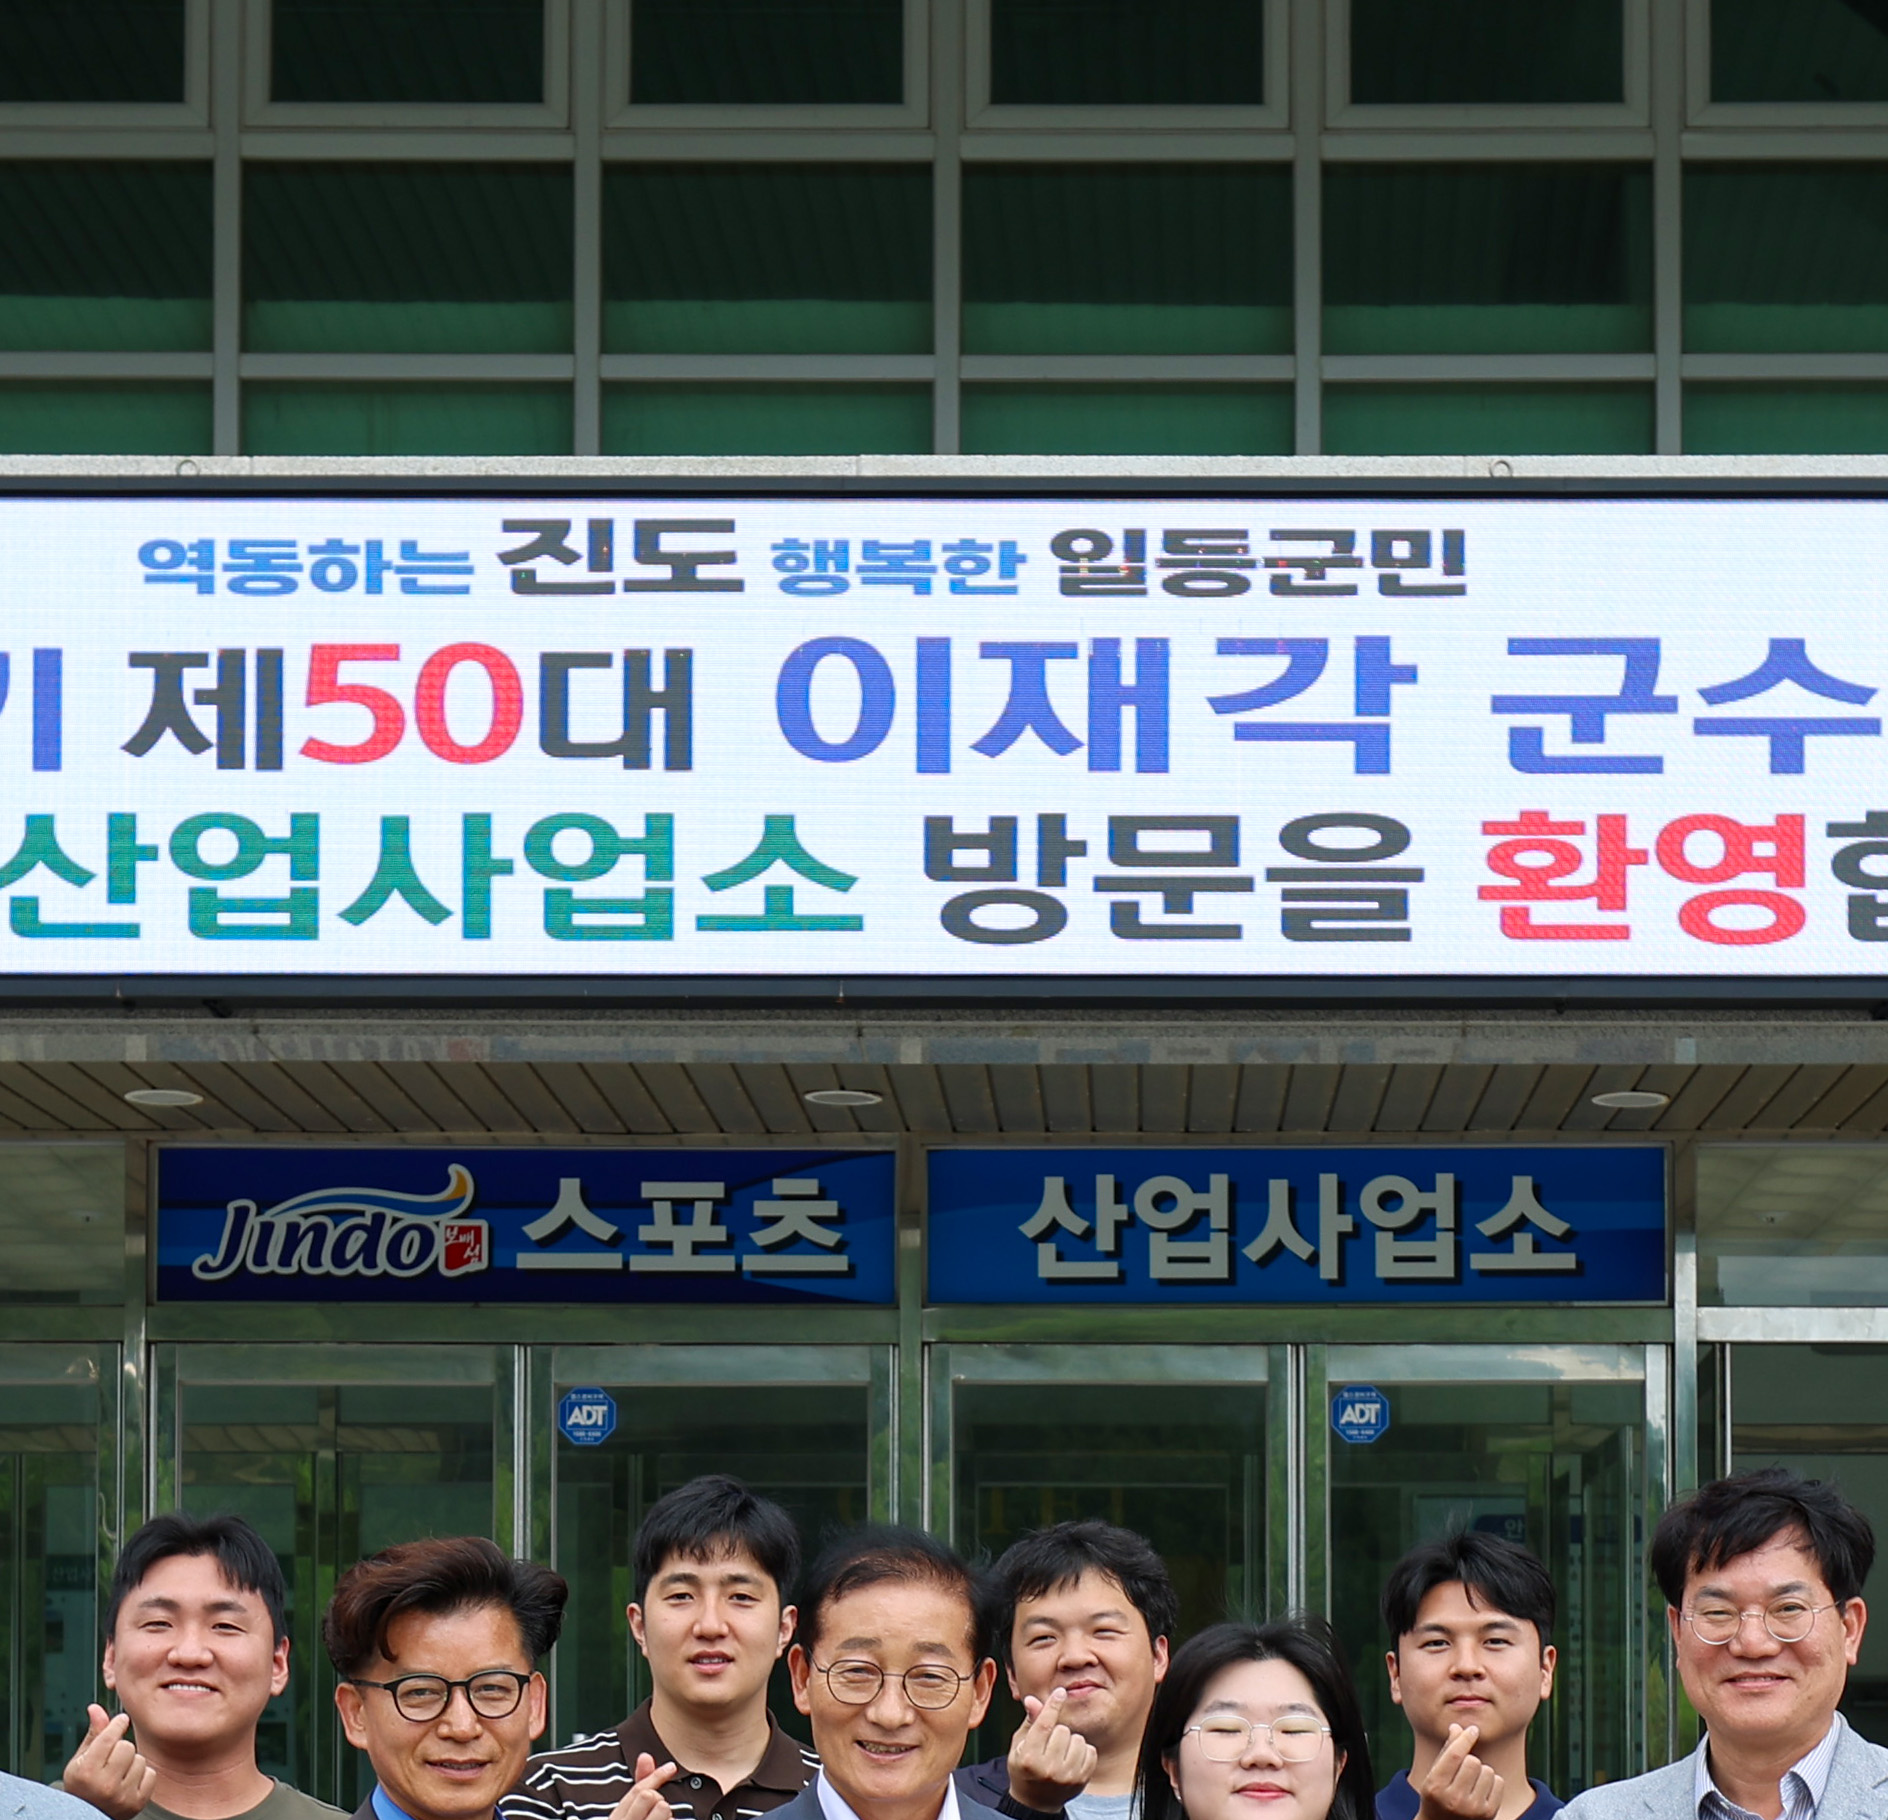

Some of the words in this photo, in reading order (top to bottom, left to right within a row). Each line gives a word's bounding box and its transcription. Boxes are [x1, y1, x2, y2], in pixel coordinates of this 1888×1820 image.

[137, 537, 475, 597] 역동하는
[497, 517, 745, 597] 진도
[770, 538, 1027, 597] 행복한
[1049, 528, 1467, 598] 일등군민
[122, 640, 694, 773] 제50대
[774, 635, 1419, 775] 이재각
[922, 812, 1425, 944] 방문을
[192, 1199, 445, 1280] Jindo
[516, 1177, 849, 1272] 스포츠
[1021, 1172, 1577, 1280] 산업사업소
[567, 1405, 608, 1426] ADT
[1339, 1403, 1381, 1424] ADT
